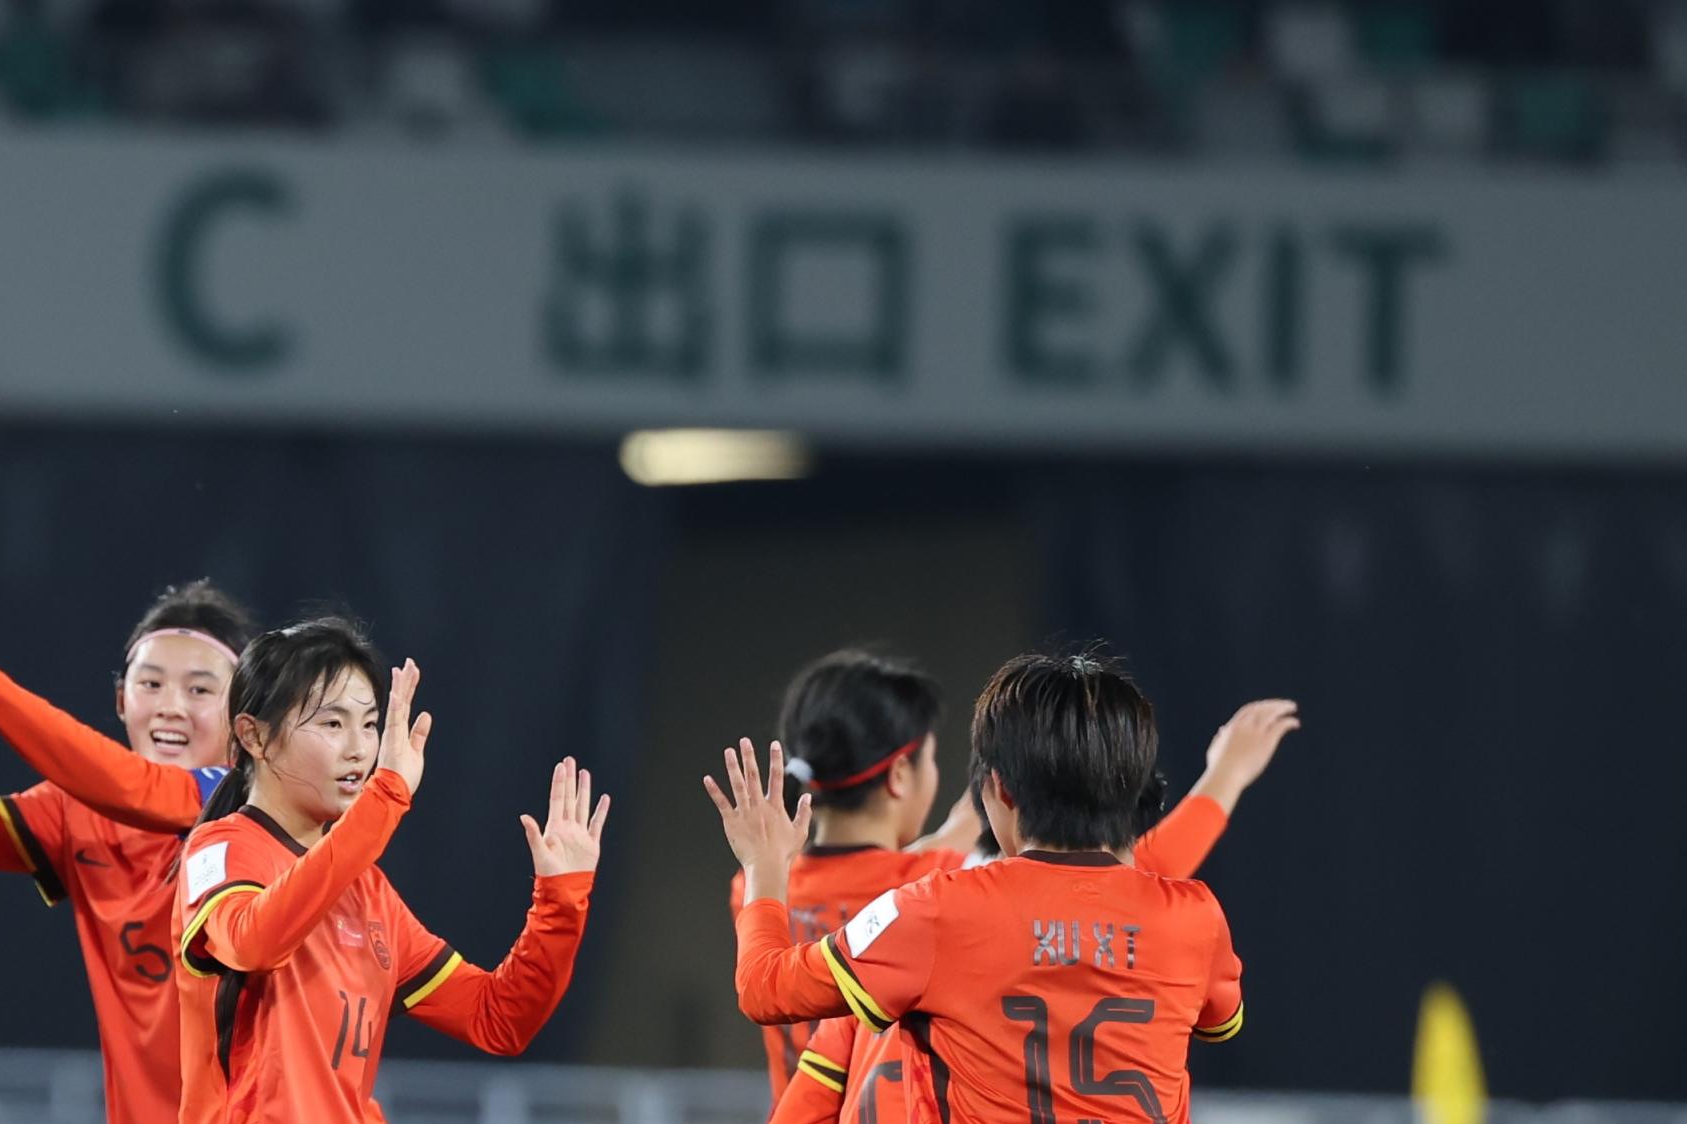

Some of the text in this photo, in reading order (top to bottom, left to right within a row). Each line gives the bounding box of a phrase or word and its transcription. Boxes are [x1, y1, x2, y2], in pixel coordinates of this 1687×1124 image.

[152, 168, 296, 372] C
[546, 182, 910, 380] 出口
[1002, 214, 1446, 390] EXIT
[119, 921, 173, 982] 5
[1033, 919, 1081, 966] XU
[331, 990, 373, 1071] 14
